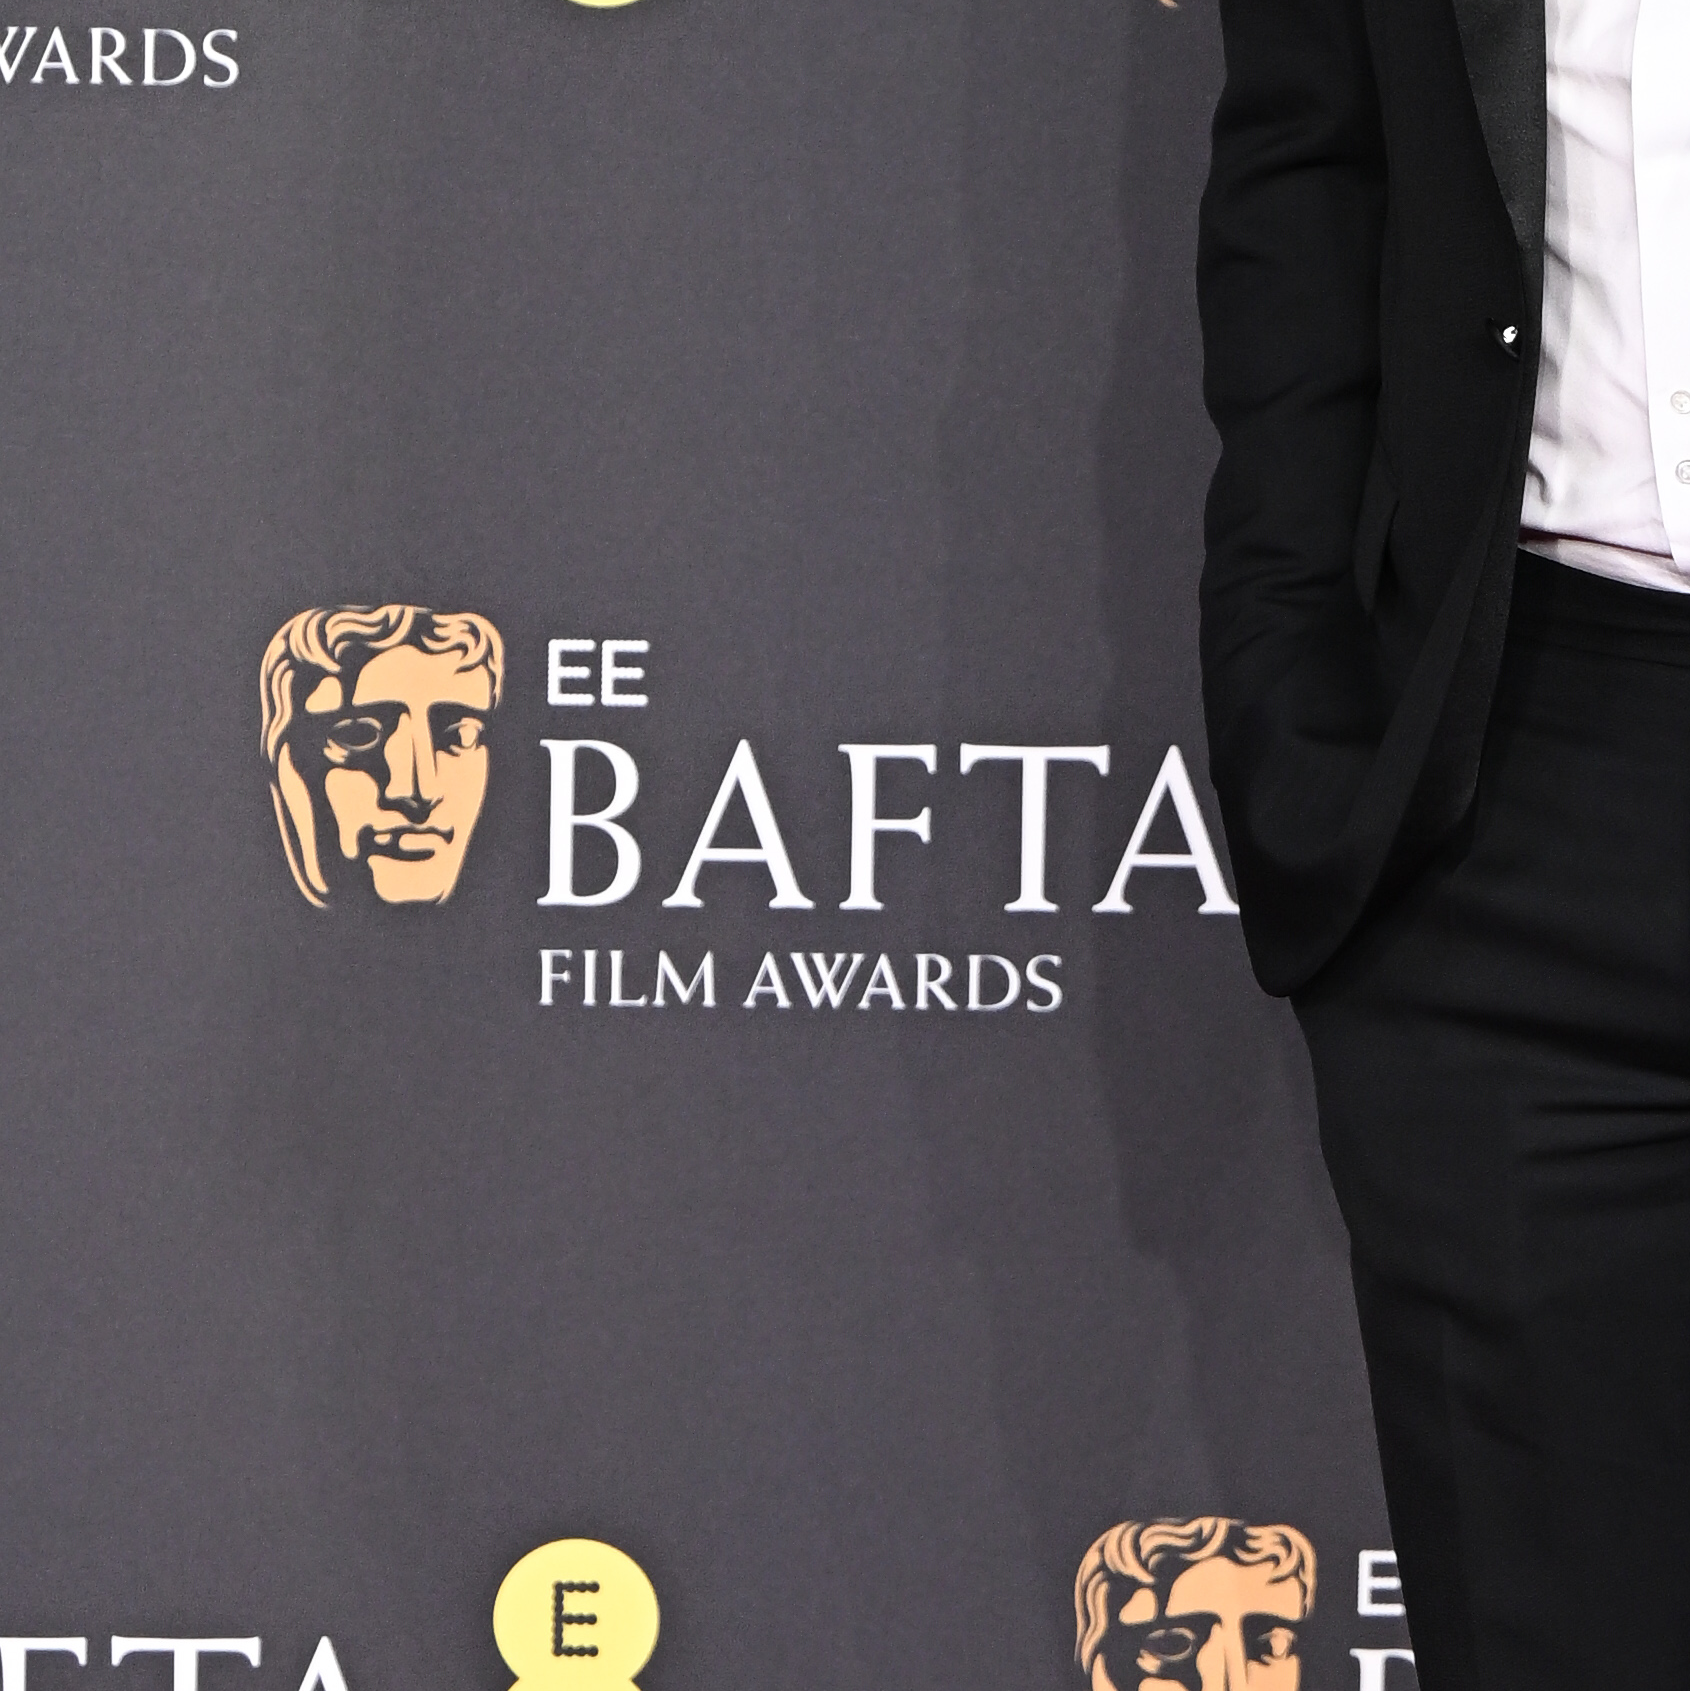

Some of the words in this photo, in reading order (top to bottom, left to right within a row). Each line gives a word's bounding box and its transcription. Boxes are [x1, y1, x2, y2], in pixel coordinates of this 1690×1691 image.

[547, 638, 650, 708] EE
[536, 738, 1240, 915] BAFTA
[539, 949, 717, 1008] FILM
[742, 951, 1062, 1012] AWARDS
